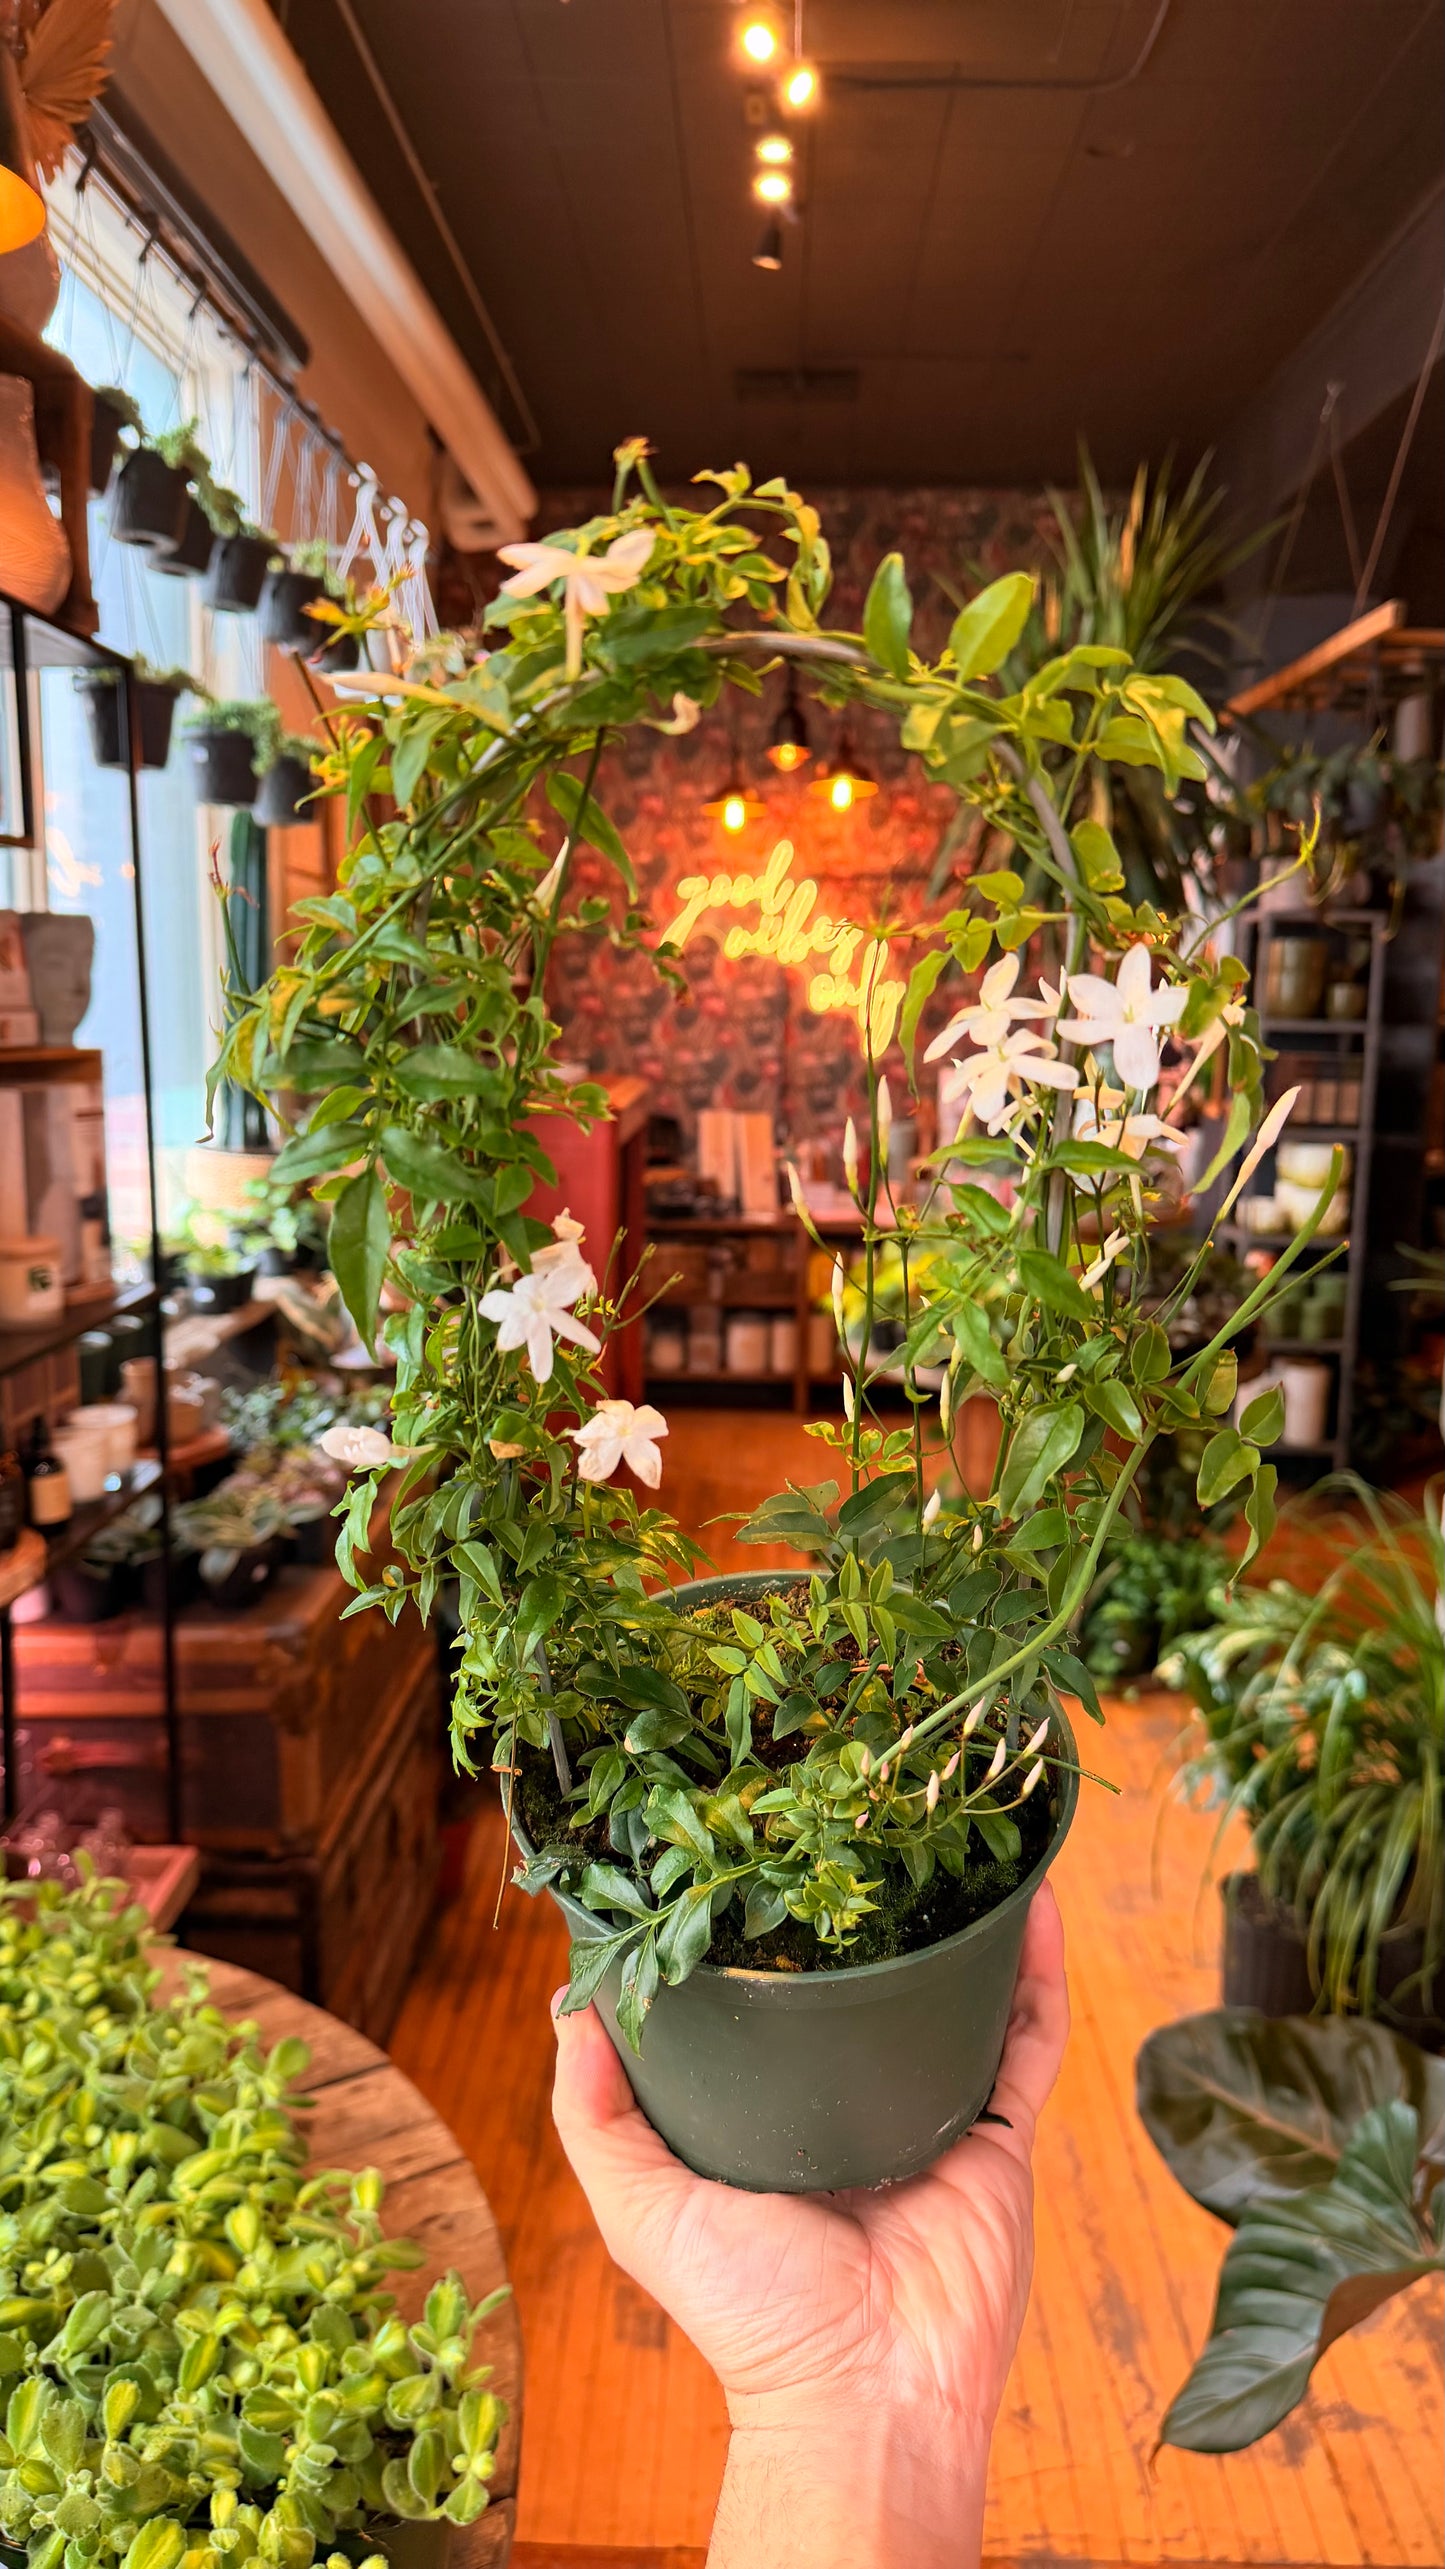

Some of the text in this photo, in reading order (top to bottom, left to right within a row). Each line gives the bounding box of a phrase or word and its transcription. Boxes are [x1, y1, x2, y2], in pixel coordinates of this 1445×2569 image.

[660, 840, 796, 949] good
[725, 879, 864, 975] vibes
[810, 939, 906, 1059] only
